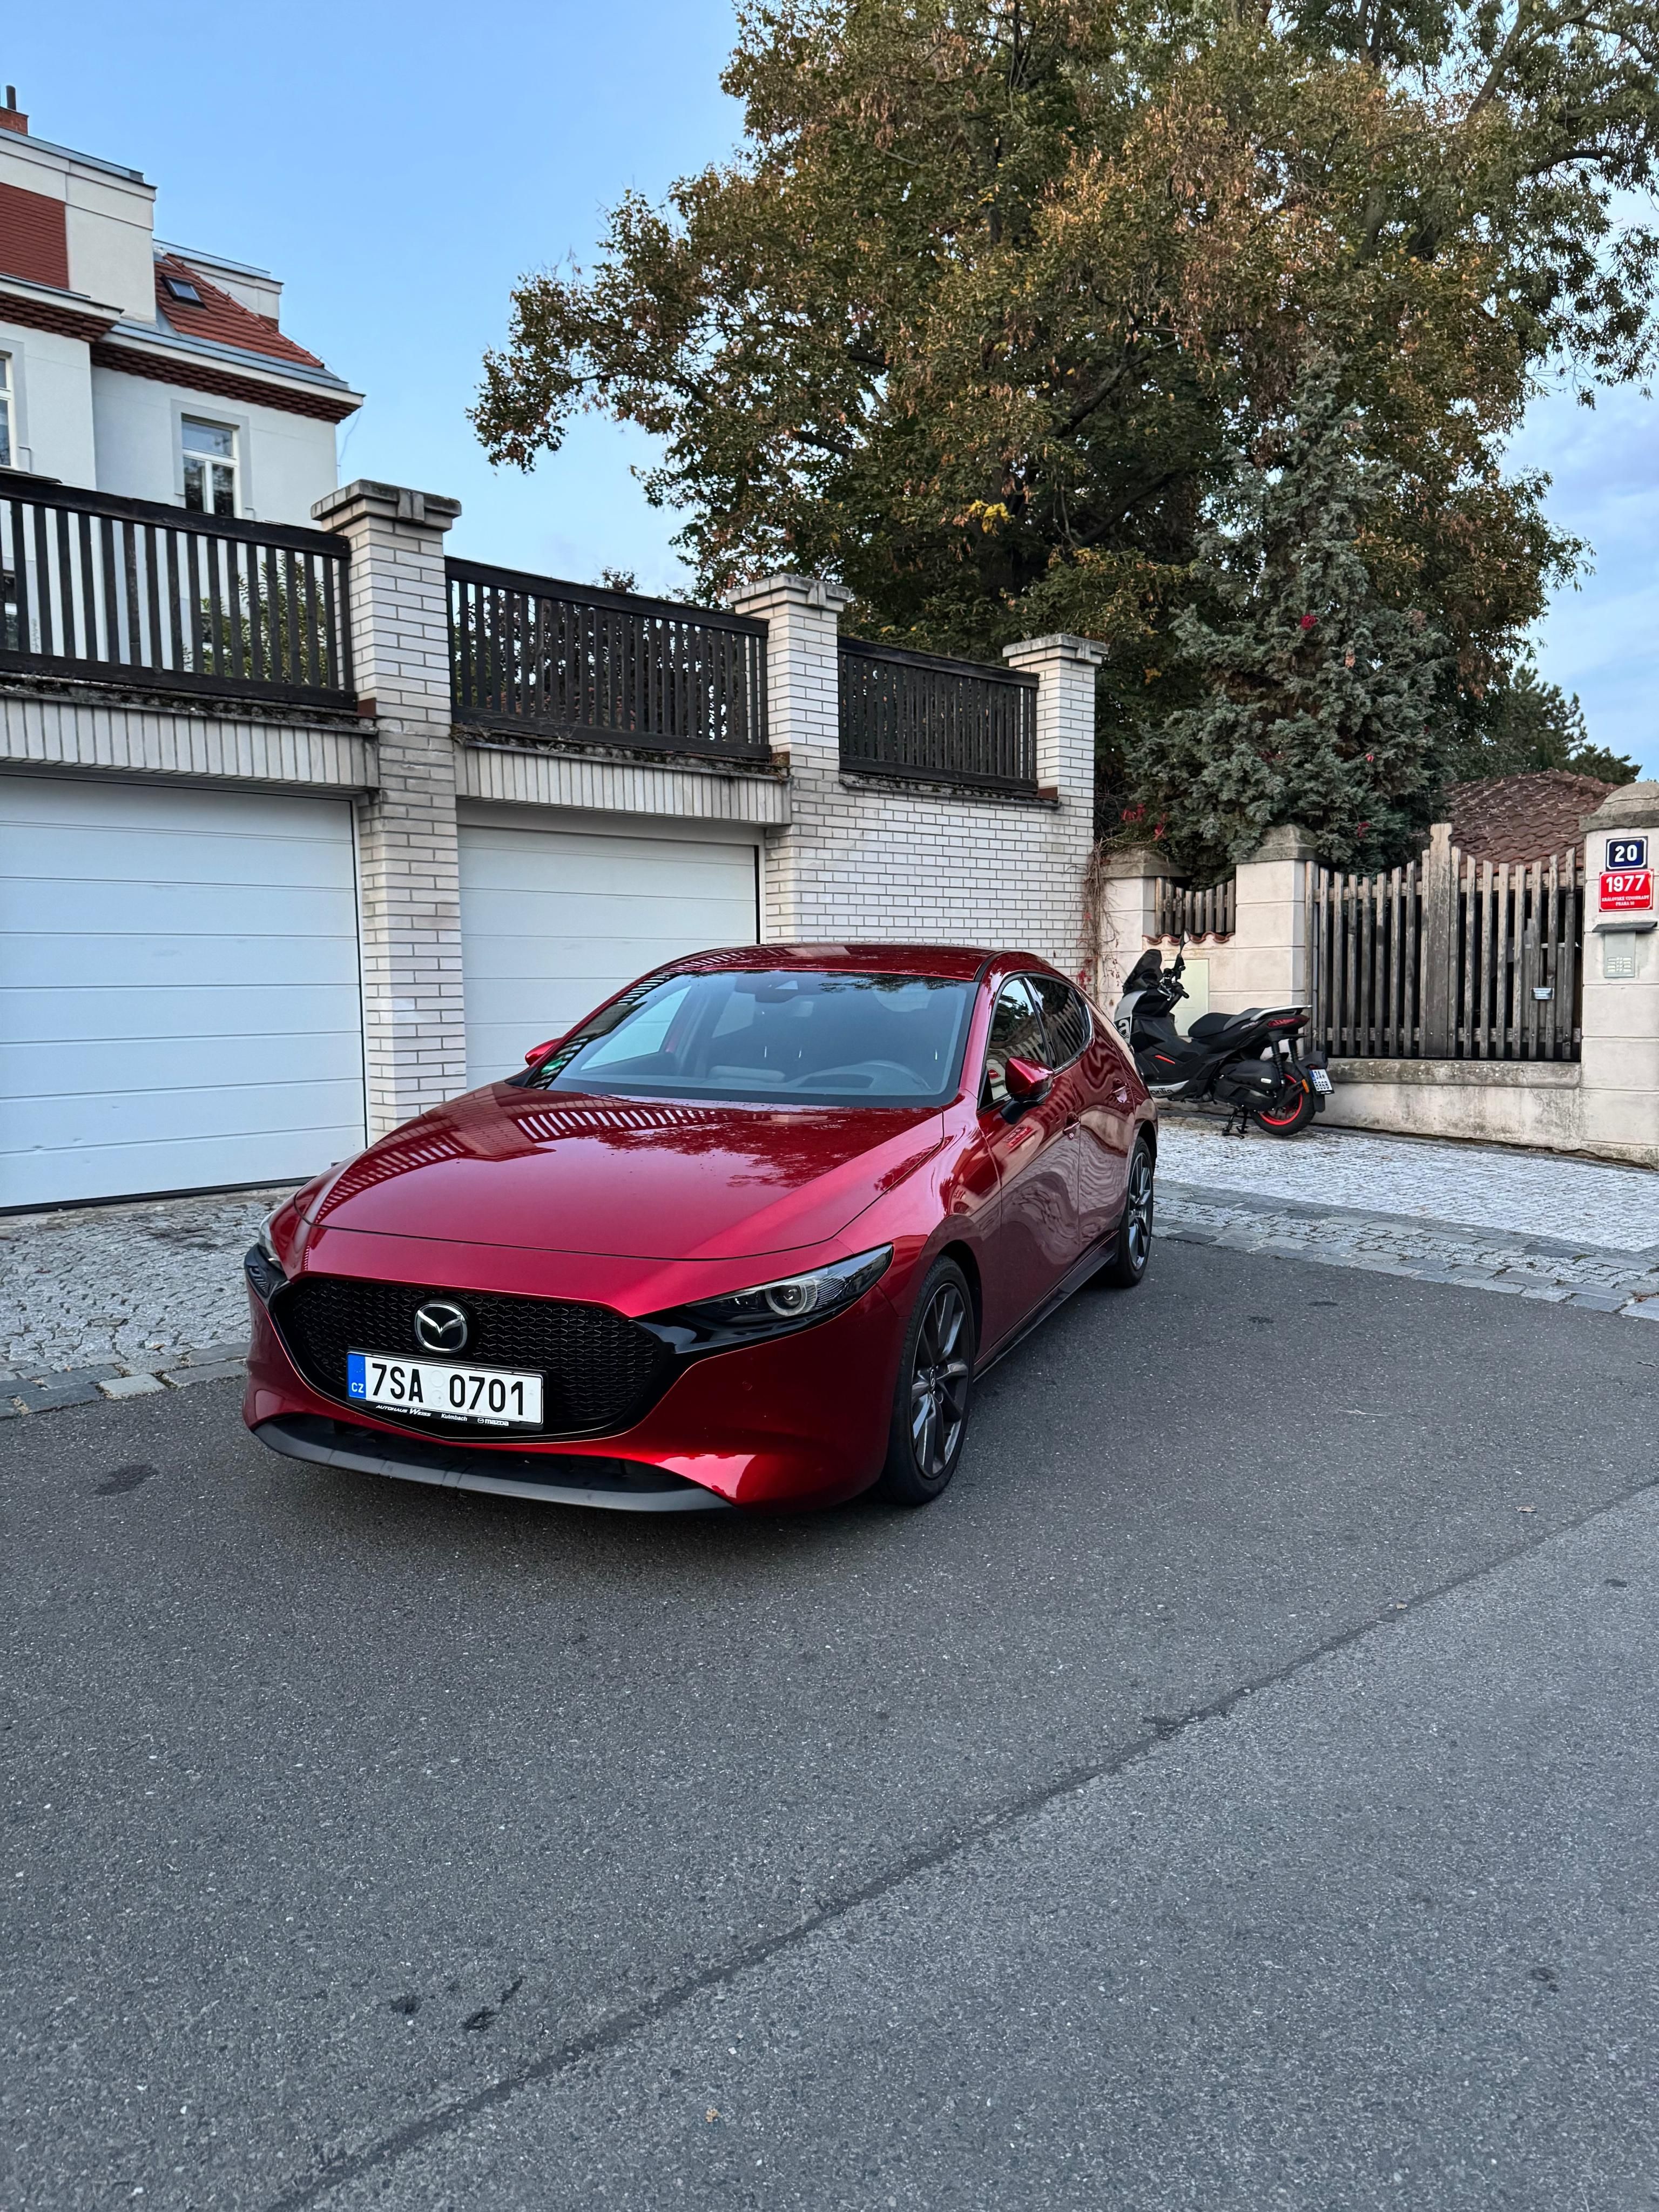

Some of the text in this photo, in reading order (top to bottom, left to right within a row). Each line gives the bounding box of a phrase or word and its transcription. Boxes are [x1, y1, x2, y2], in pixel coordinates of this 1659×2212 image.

[1614, 844, 1637, 862] 20
[1606, 874, 1645, 893] 1977
[351, 1381, 365, 1393] CZ
[372, 1363, 524, 1416] 7SA 0701
[376, 1404, 408, 1413] AUTOHAUS
[441, 1413, 468, 1422] Kulmbach
[484, 1418, 509, 1426] mazda
